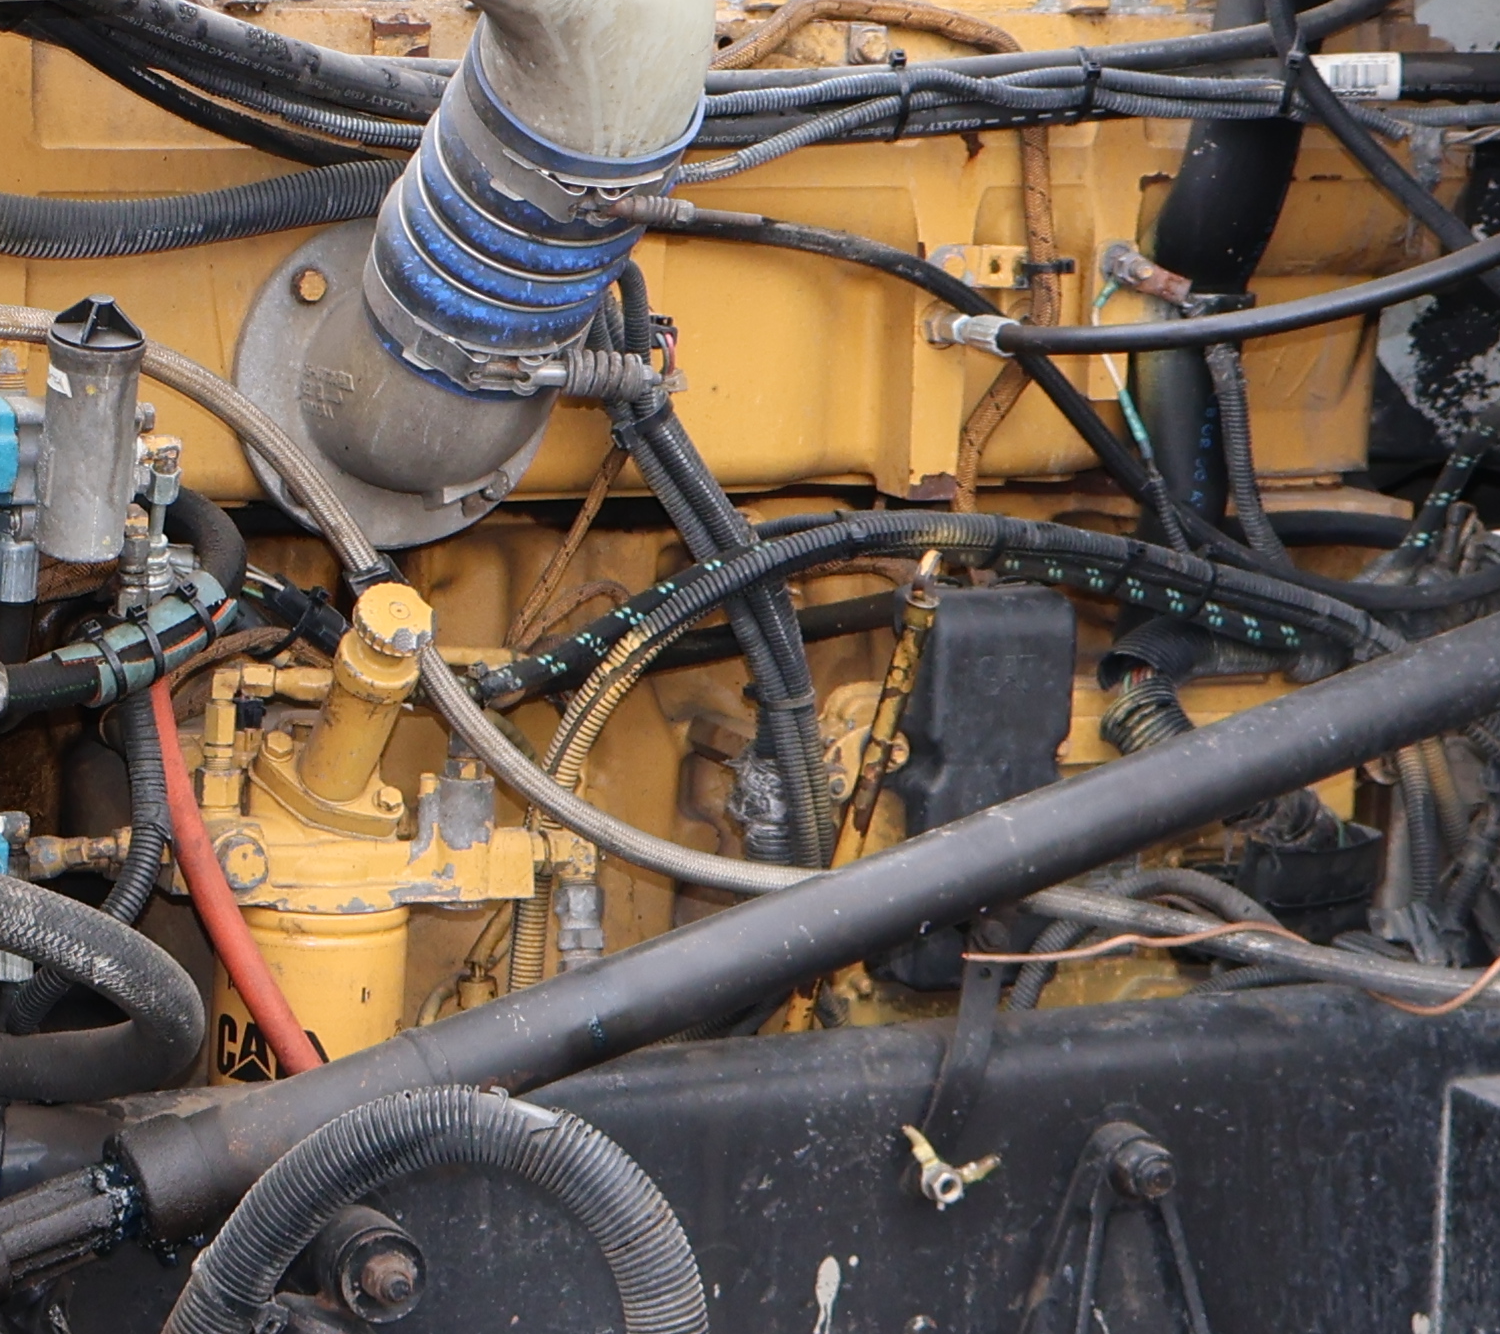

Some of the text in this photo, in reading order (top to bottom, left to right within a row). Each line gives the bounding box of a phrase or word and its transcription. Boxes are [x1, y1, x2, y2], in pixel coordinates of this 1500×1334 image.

[142, 19, 169, 39] HOSE
[168, 27, 209, 54] SUCTION
[926, 117, 982, 132] GALAXY
